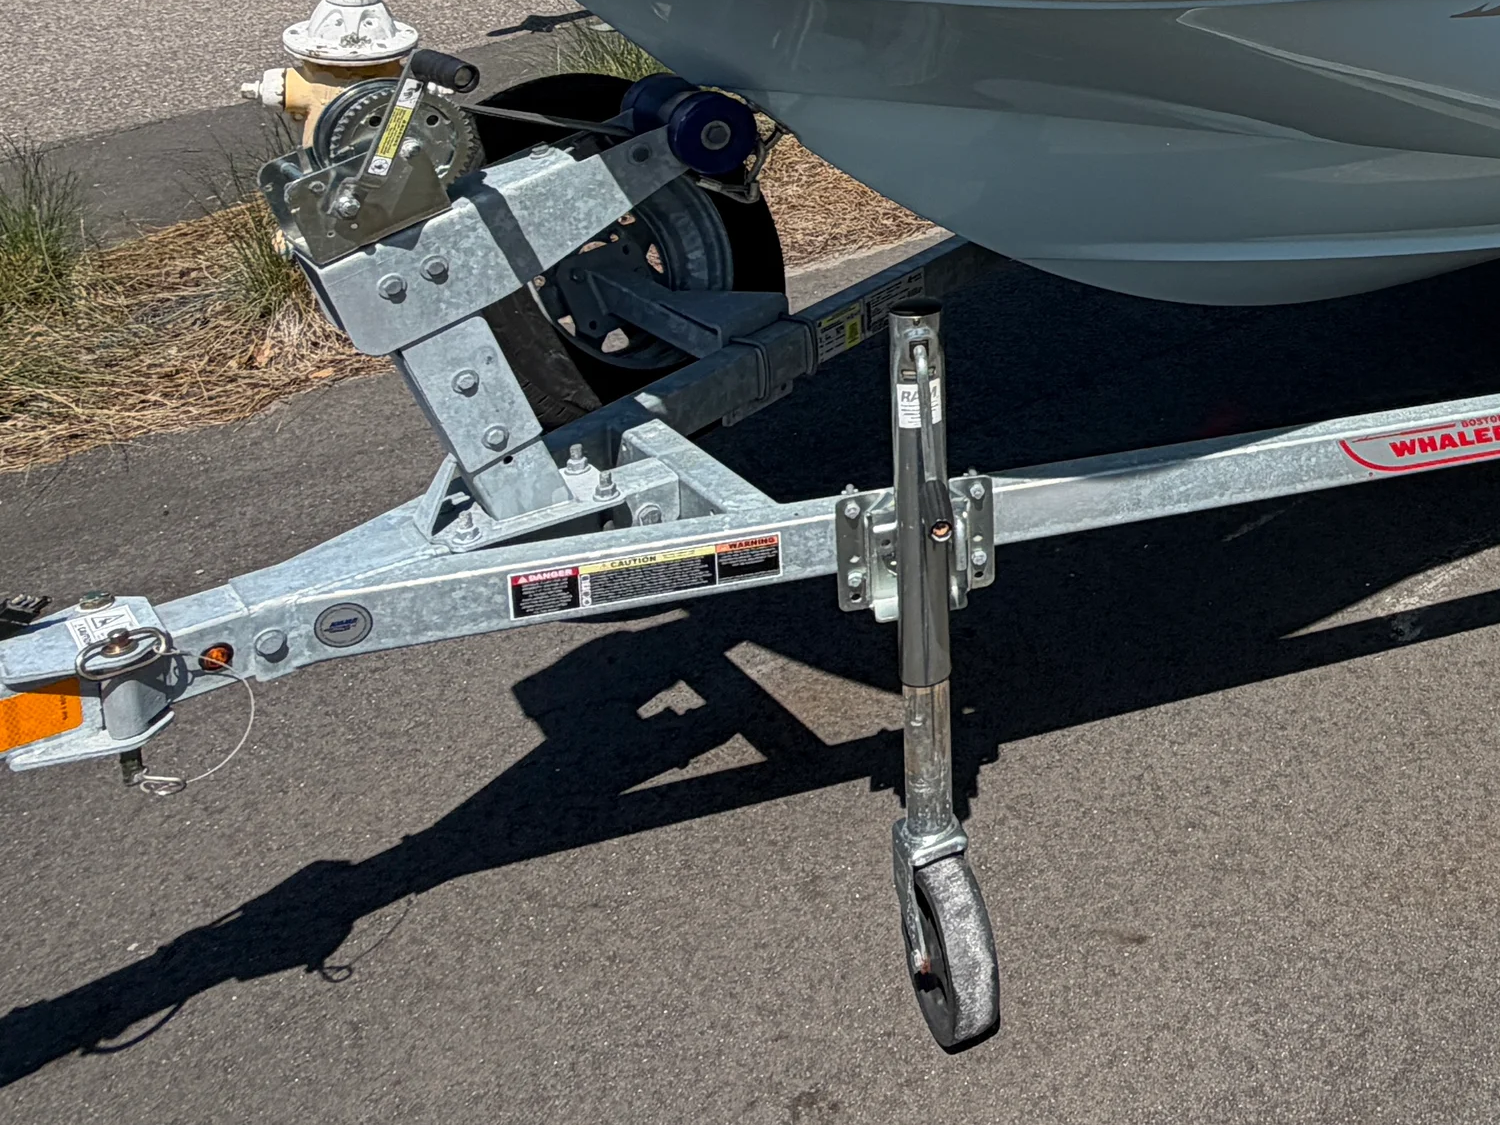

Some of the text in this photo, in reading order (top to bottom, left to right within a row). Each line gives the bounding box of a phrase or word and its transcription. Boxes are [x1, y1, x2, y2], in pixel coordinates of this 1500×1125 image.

[728, 536, 776, 550] WARNING
[610, 555, 657, 569] CAUTION
[528, 568, 573, 582] DANGER
